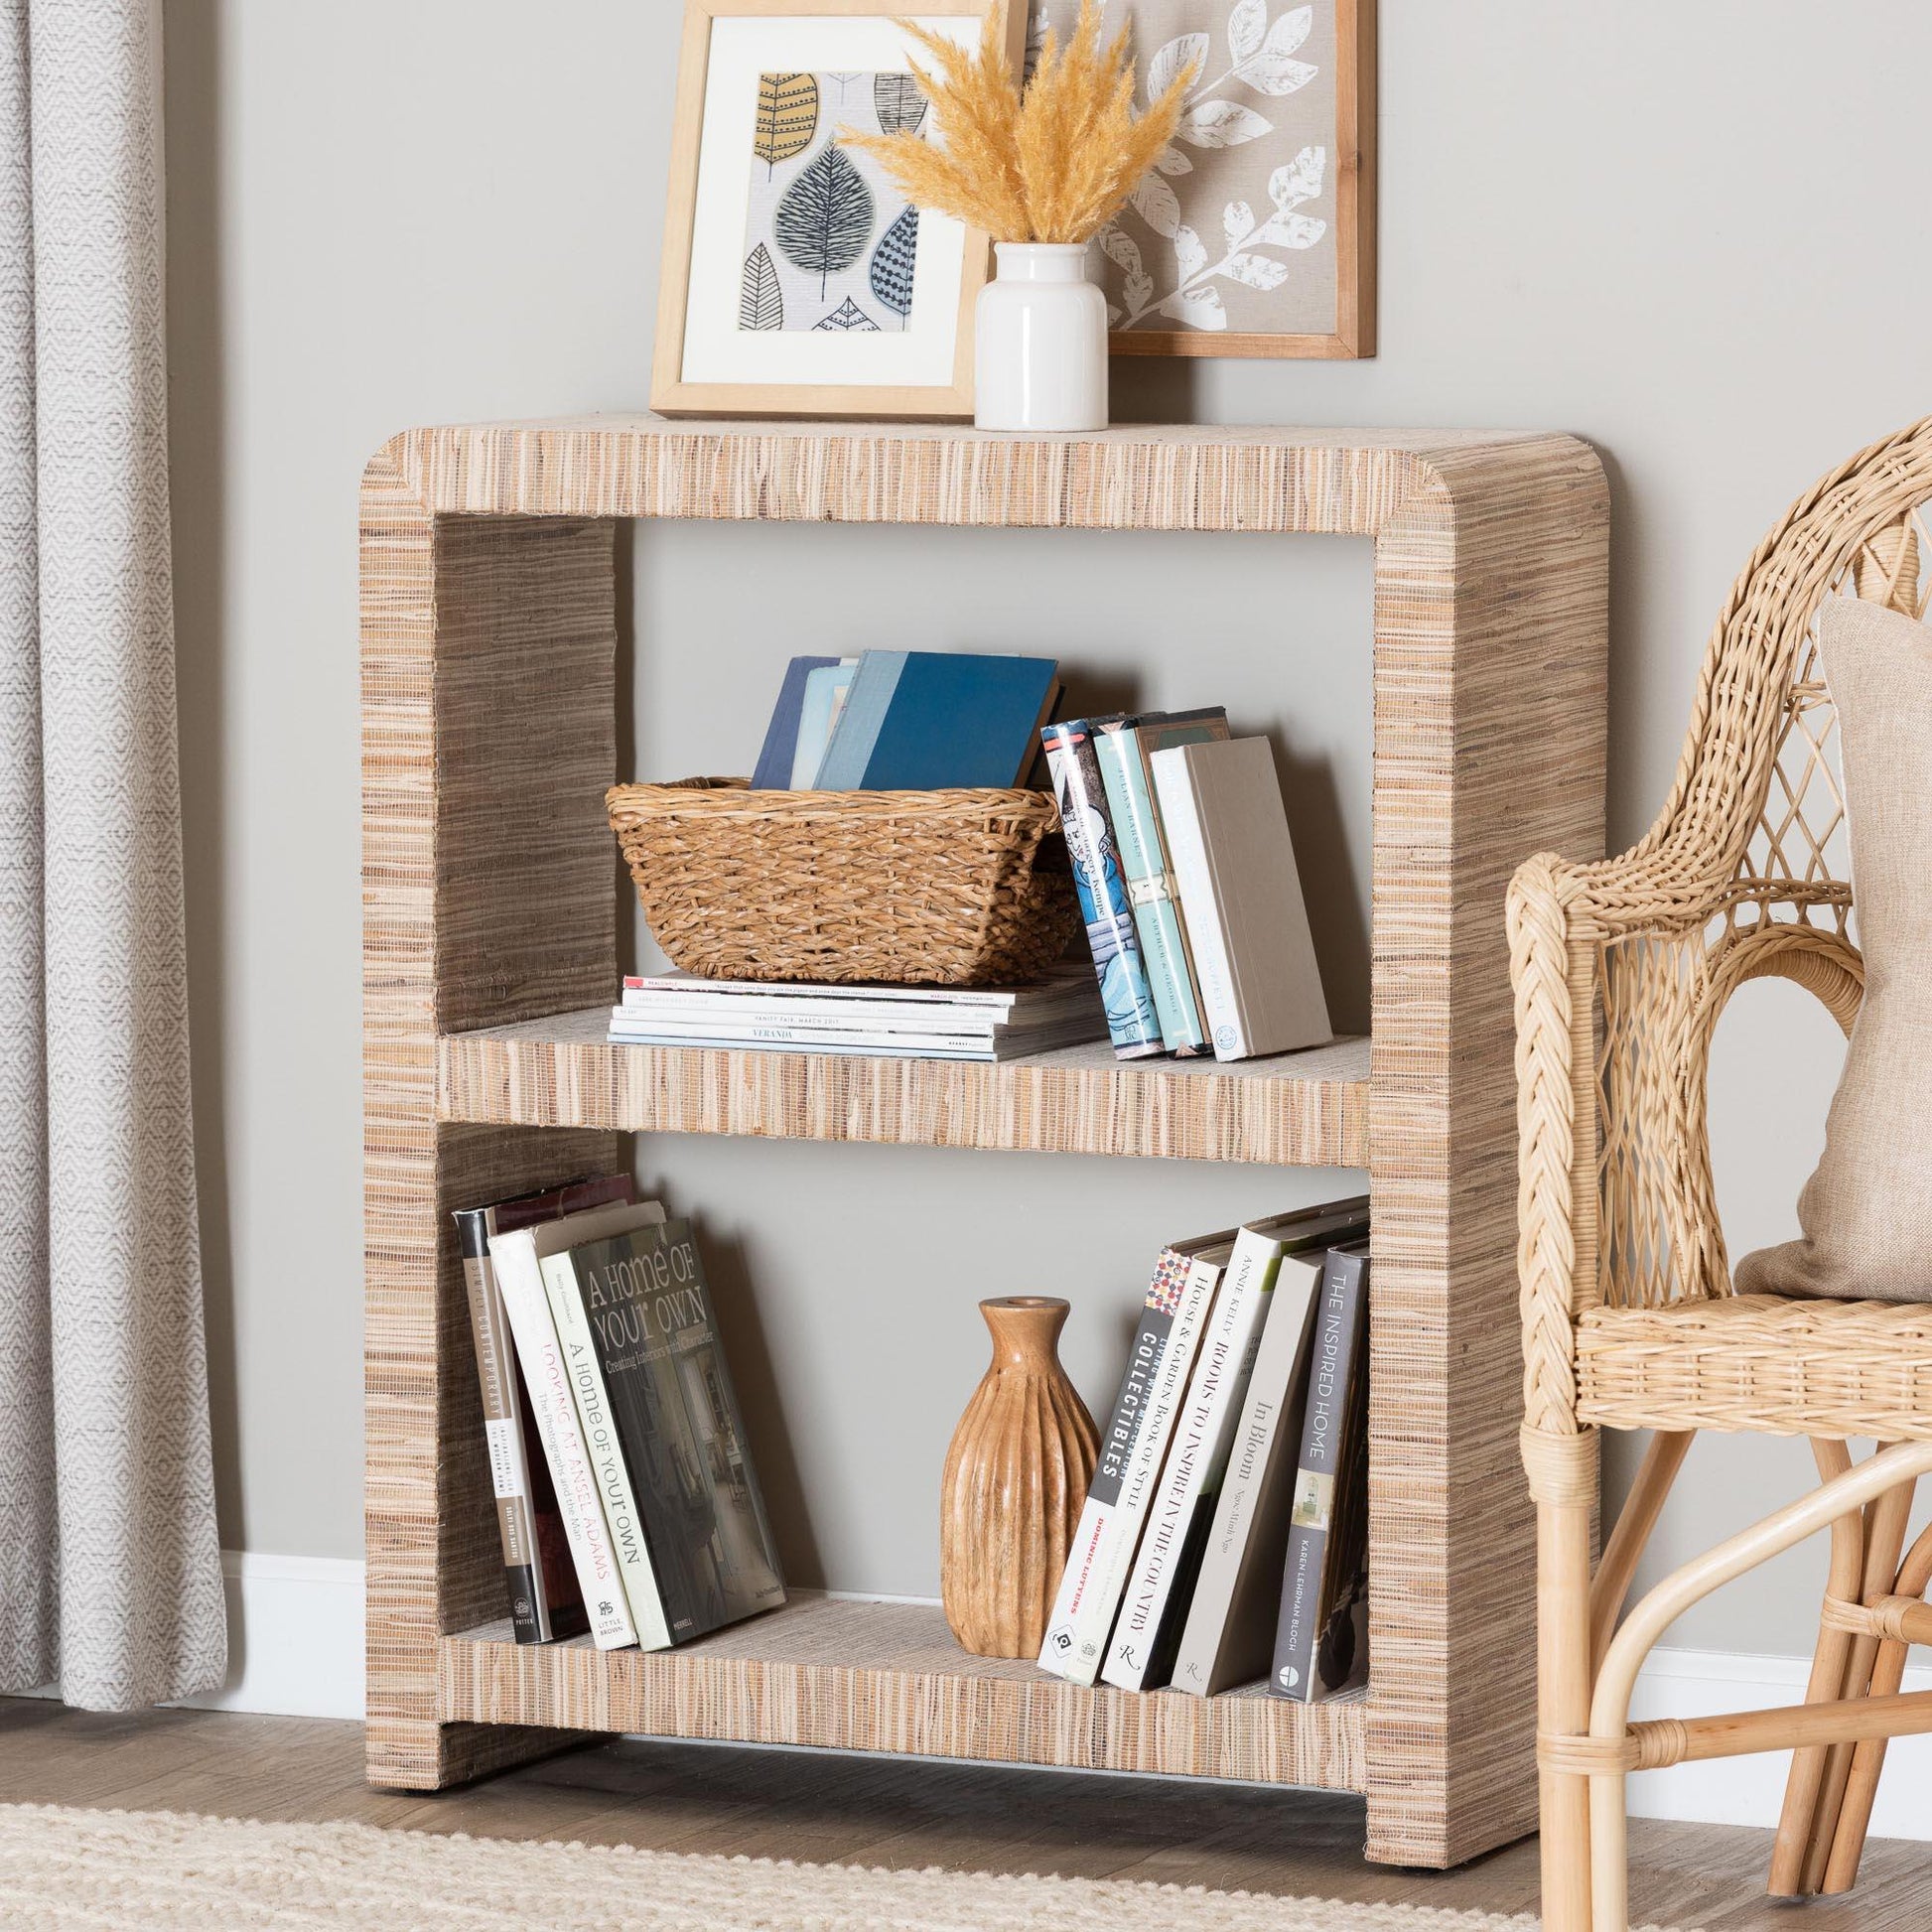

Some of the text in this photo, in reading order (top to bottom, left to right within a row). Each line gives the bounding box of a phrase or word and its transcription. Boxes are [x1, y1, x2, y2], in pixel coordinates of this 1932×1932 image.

[1128, 814, 1144, 859] BARNES
[753, 1028, 793, 1039] VERANDA
[589, 1271, 608, 1309] A
[670, 1242, 695, 1283] OF
[1222, 1255, 1253, 1336] ANNIE KELLY
[470, 1264, 501, 1415] SIMPLY CONTEMPORARY
[655, 1286, 707, 1333] OWN
[1178, 1327, 1190, 1338] &
[605, 1356, 637, 1375] Creating
[1309, 1274, 1347, 1459] THE INSPIRED HOME
[1102, 1331, 1158, 1478] COLLECTIBLES
[1120, 1337, 1169, 1481] LIVING WITH MID-CENTURY
[1254, 1401, 1274, 1421] In
[538, 1392, 583, 1541] The Photographs and the Man
[543, 1342, 611, 1581] LOOKING AT ANSEL ADAMS
[569, 1342, 584, 1358] A
[593, 1429, 612, 1452] OF
[616, 1515, 640, 1565] OWN
[1239, 1425, 1268, 1480] Bloom
[1130, 1341, 1230, 1636] ROOMS TO INSPIRE IN THE COUNTRY
[1222, 1537, 1233, 1554] Ngo
[1225, 1510, 1241, 1537] Minh
[1070, 1517, 1105, 1616] DOMINIC LUTYENS
[1288, 1539, 1311, 1652] KAREN LEHRMAN BLOCH
[600, 1626, 623, 1636] BROWN
[1120, 1644, 1141, 1671] R
